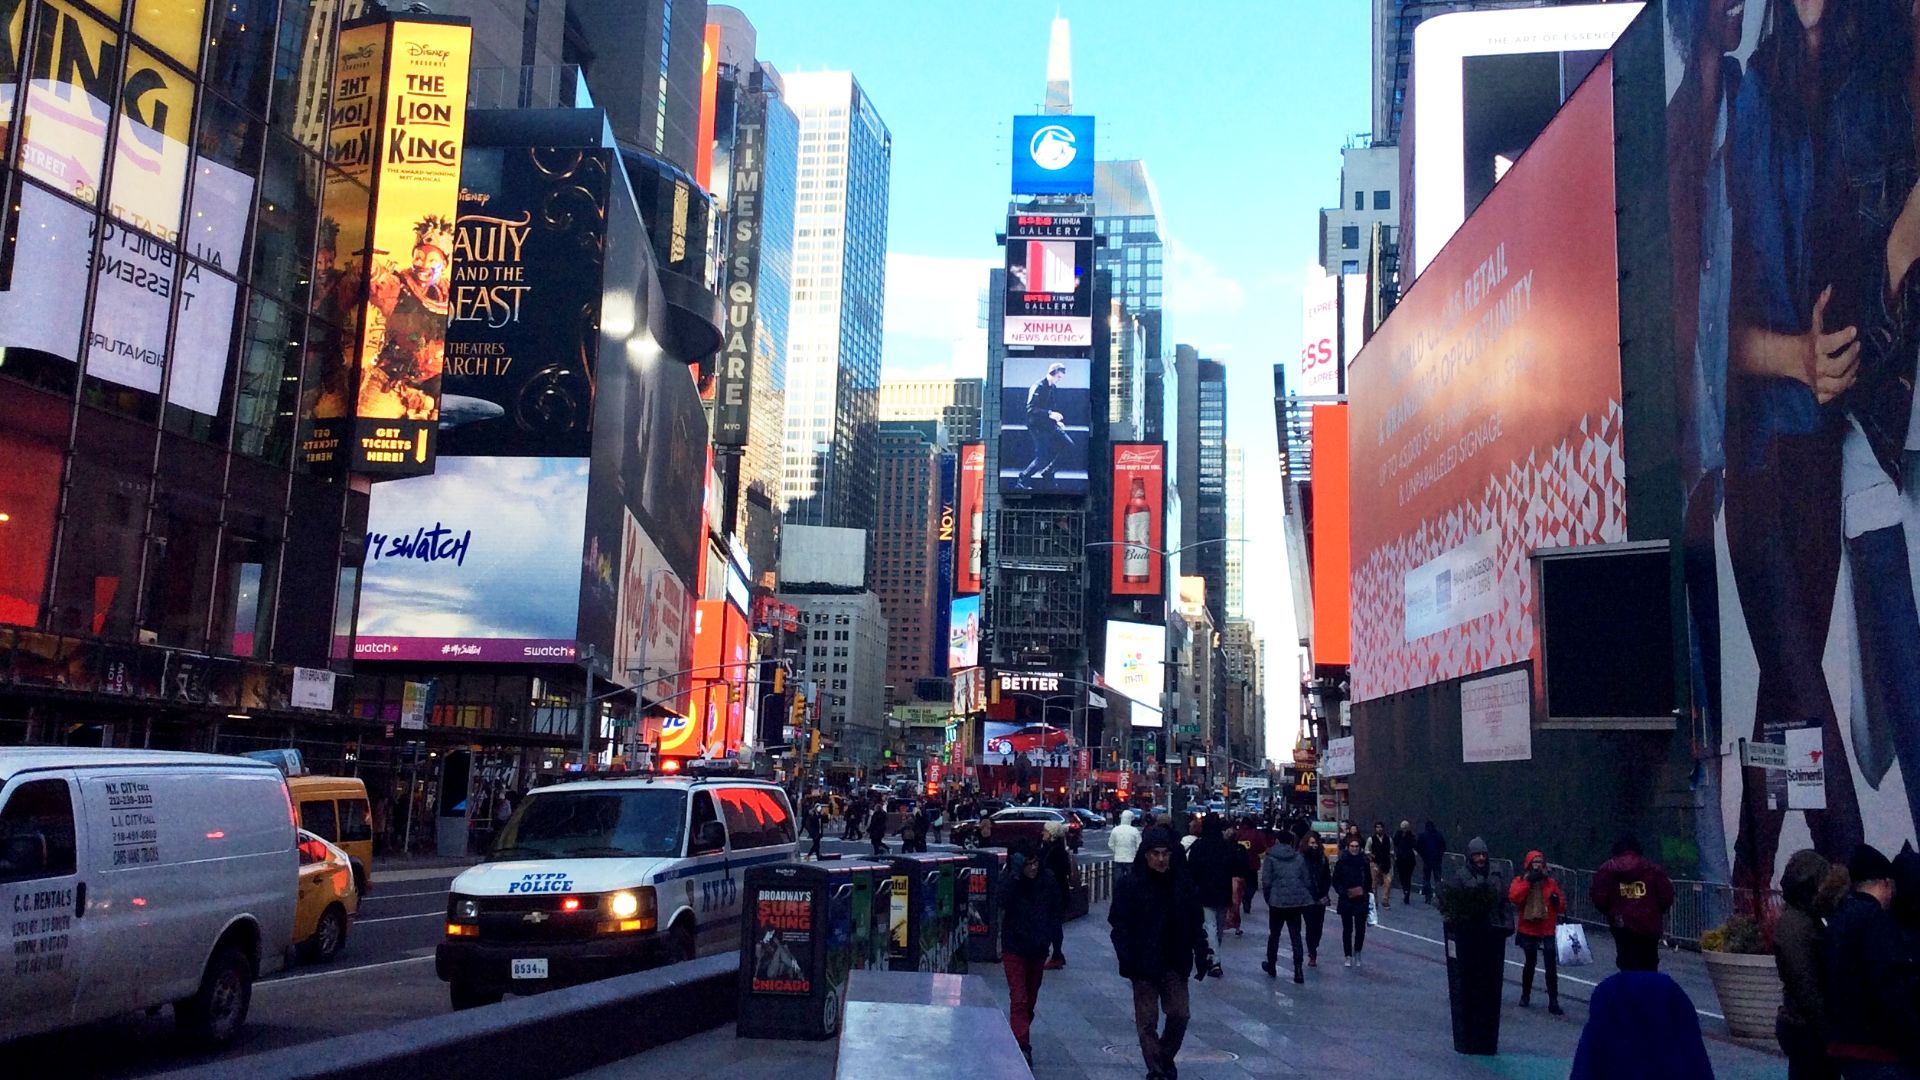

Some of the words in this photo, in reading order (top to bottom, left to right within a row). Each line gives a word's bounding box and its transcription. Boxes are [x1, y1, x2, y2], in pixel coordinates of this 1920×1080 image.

[406, 74, 446, 93] THE
[396, 95, 451, 125] LION
[388, 128, 456, 164] KING
[736, 124, 760, 242] TIMES
[1053, 217, 1081, 226] XINHUA
[1020, 227, 1081, 235] GALLERY
[455, 267, 489, 281] AND
[494, 267, 524, 281] THE
[1464, 241, 1509, 311] RETAIL
[1025, 303, 1075, 311] GALLERY
[725, 257, 753, 405] SQUARE
[1023, 323, 1073, 333] XINHUA
[1012, 333, 1041, 342] NEWS
[1043, 334, 1085, 342] AGENCY
[449, 343, 505, 355] THEATRES
[495, 357, 513, 376] 17
[376, 428, 400, 438] GET
[724, 423, 740, 431] NYC
[362, 438, 412, 450] TICKETS
[1460, 412, 1503, 464] SIGNAGE
[367, 451, 404, 463] HERE!
[524, 646, 568, 657] swatch
[1001, 677, 1058, 691] BETTER
[120, 782, 137, 794] CITY
[125, 814, 142, 826] CITY
[508, 880, 573, 893] POLICE
[34, 889, 72, 911] RENTALS
[703, 877, 737, 912] NYPD
[758, 890, 812, 901] BROADWAY'S
[758, 901, 811, 916] SURE
[758, 916, 811, 929] THING
[752, 980, 810, 991] CHICAGO
